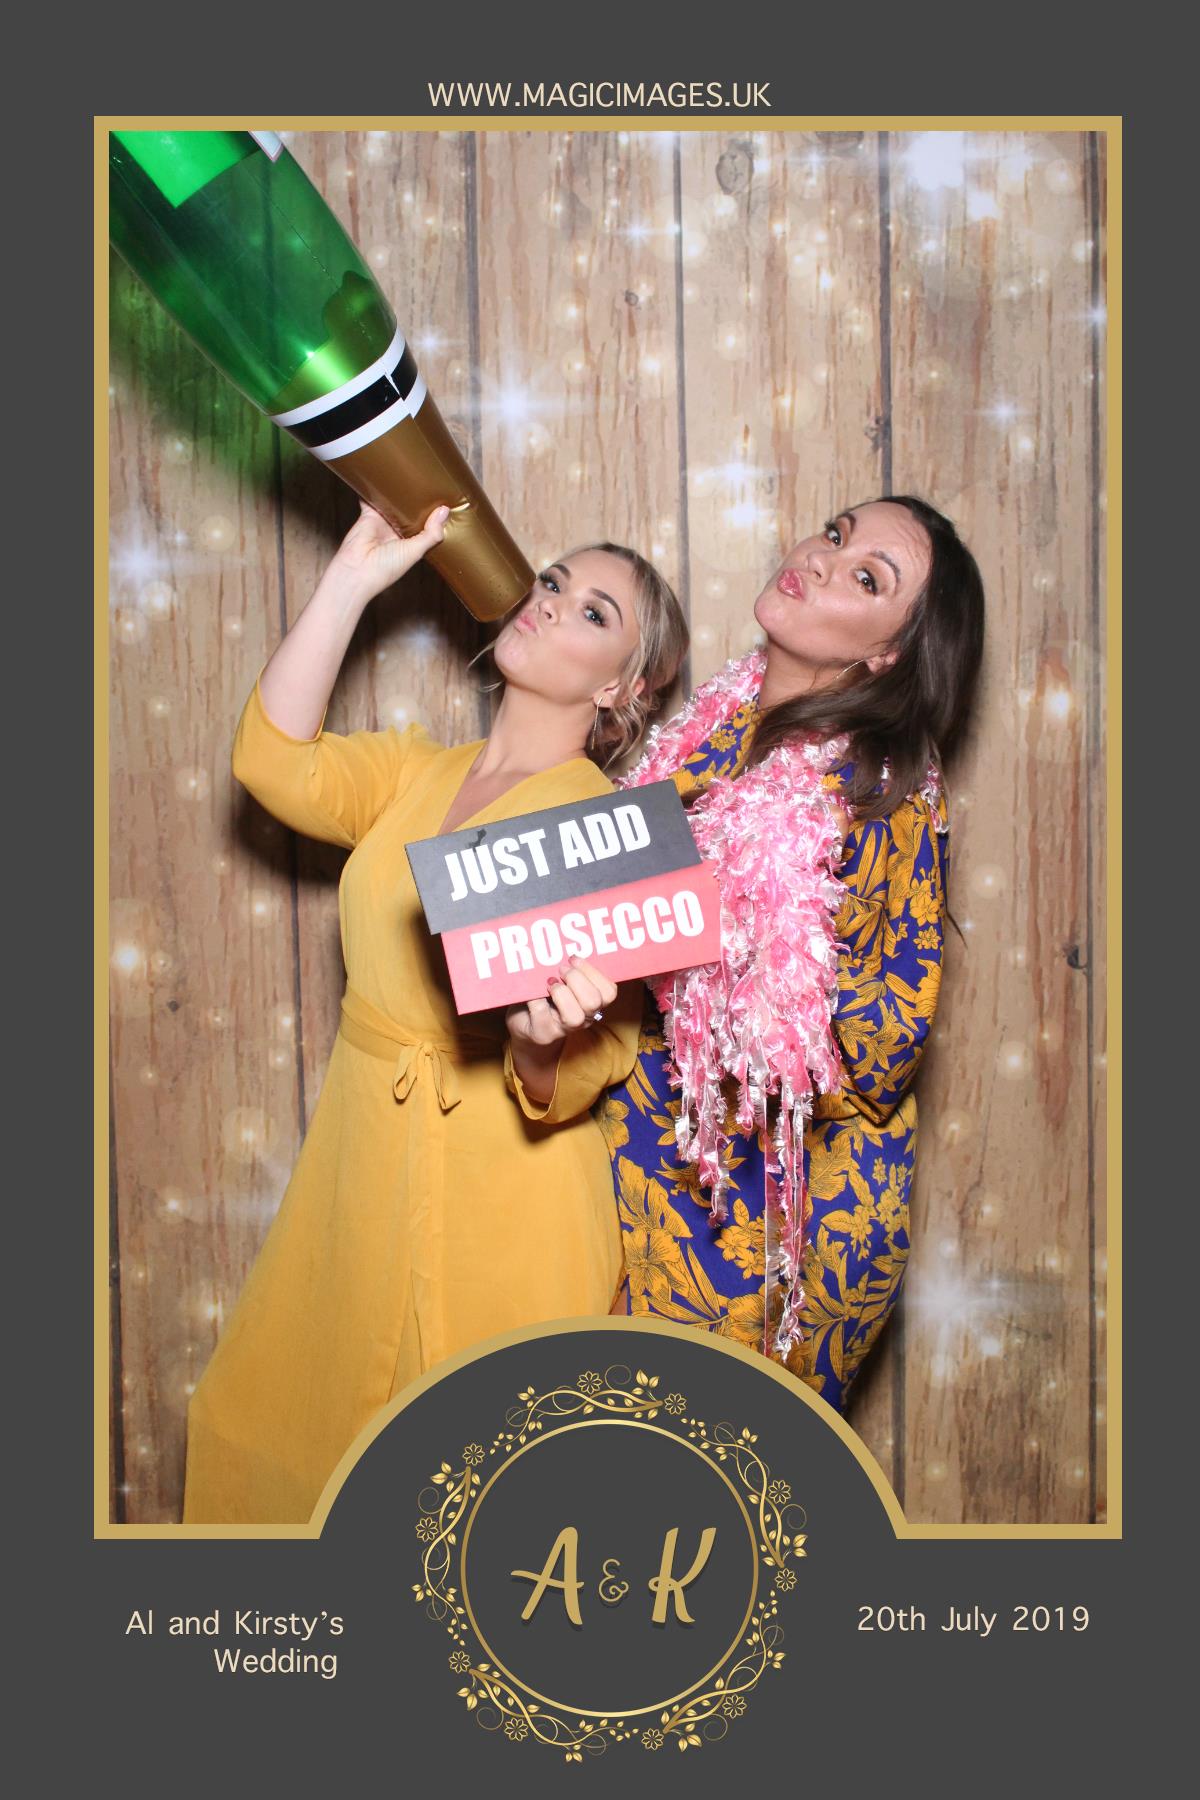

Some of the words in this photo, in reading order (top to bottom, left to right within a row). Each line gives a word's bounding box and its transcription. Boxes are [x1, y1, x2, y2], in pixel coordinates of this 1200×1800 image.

[444, 828, 551, 902] JUST
[557, 803, 652, 869] ADD
[469, 889, 705, 980] PROSECCO
